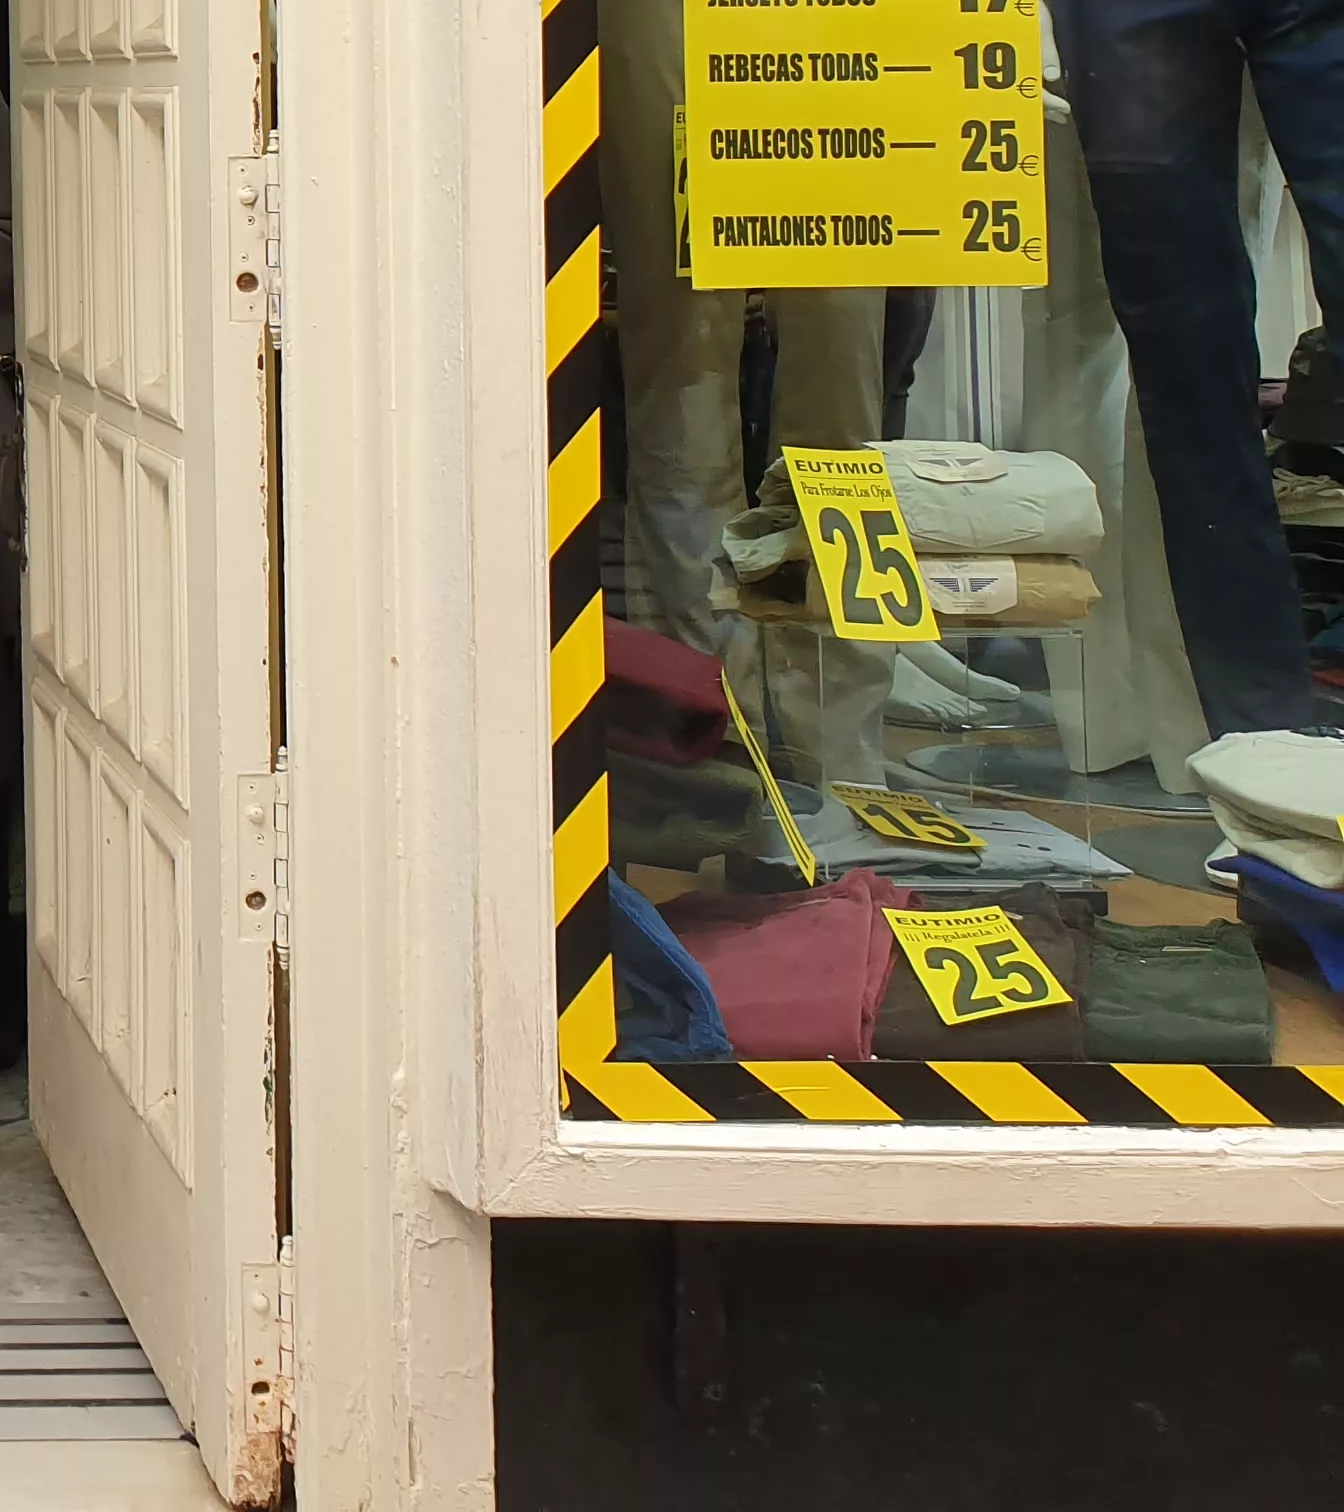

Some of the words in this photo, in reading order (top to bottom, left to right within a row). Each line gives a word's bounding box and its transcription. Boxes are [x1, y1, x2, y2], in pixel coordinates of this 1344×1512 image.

[708, 52, 804, 82] REBECAS
[808, 52, 879, 81] TODAS
[710, 128, 815, 160] CHALECOS
[818, 127, 886, 159] TODOS
[712, 216, 827, 247] PANTALONES
[831, 215, 894, 246] TODOS
[794, 459, 884, 475] EUTIMIO
[800, 481, 820, 496] Para
[854, 484, 870, 498] Los
[870, 485, 893, 503] Ojos
[818, 506, 923, 627] 25
[862, 803, 972, 844] 15
[894, 913, 1001, 927] EUTIMIO
[921, 928, 993, 944] Regalatela
[923, 938, 1050, 1017] 25
